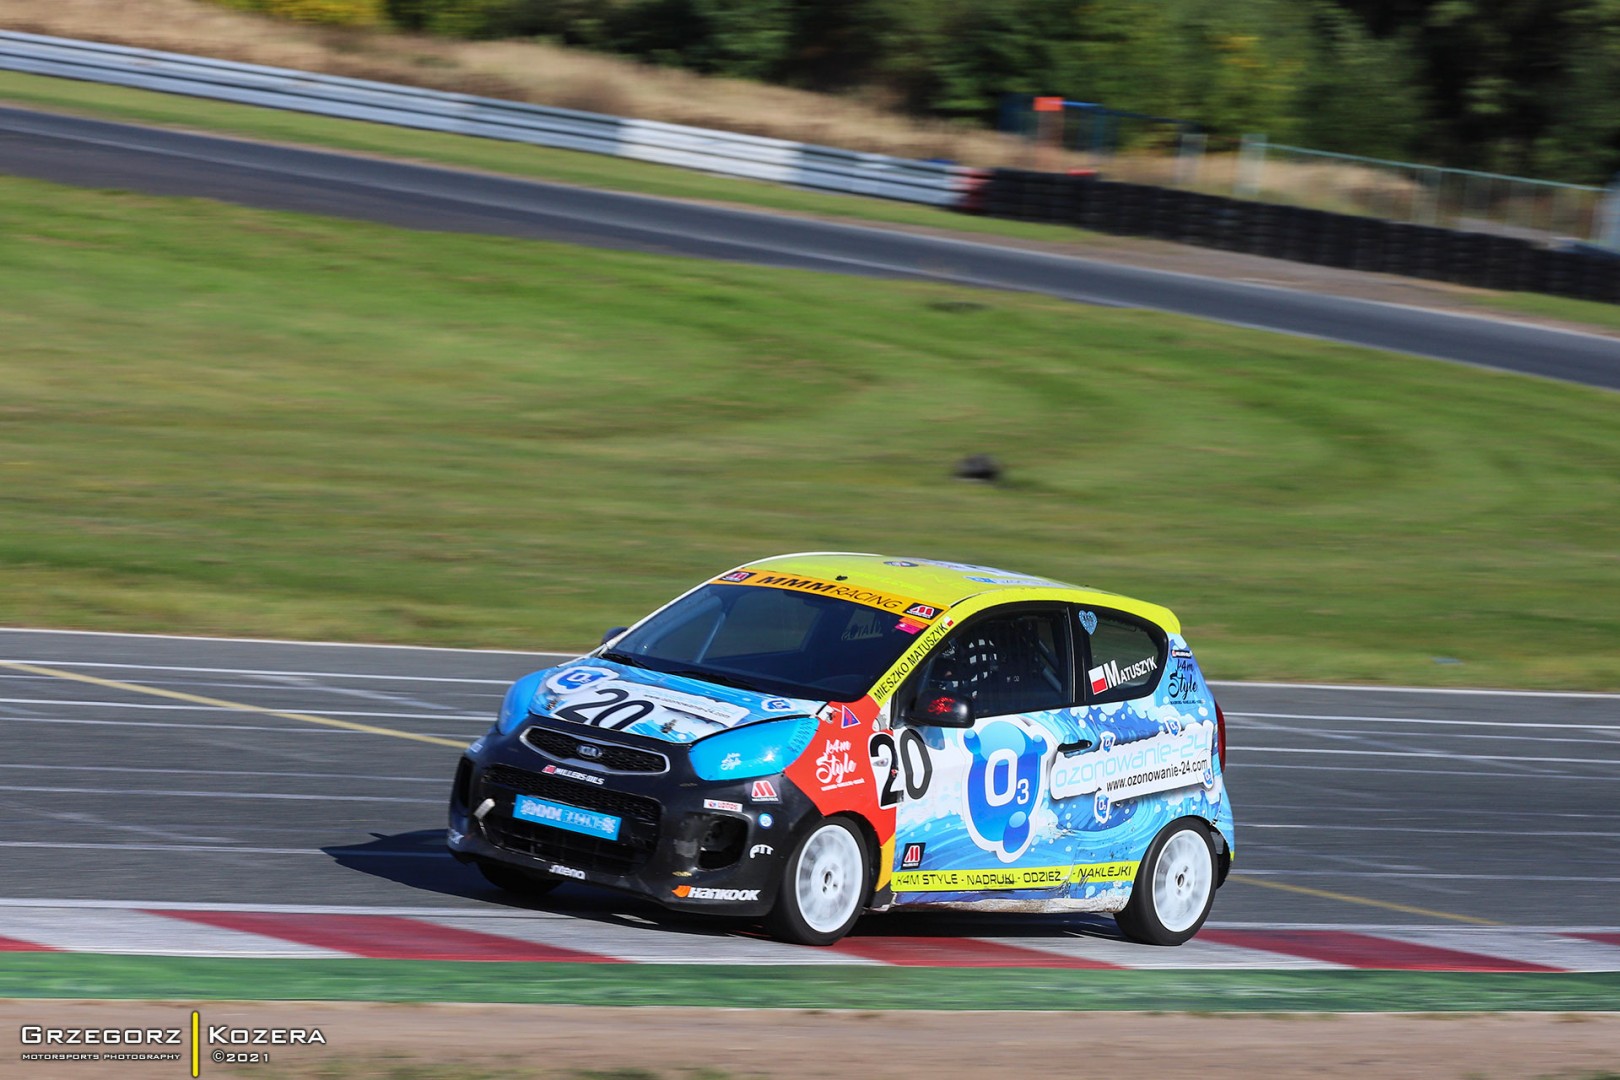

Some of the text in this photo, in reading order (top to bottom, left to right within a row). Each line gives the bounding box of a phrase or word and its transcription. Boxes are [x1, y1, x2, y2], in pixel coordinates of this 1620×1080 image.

[873, 662, 910, 701] MIESZKO
[907, 622, 949, 667] MATUSZYK
[1167, 669, 1199, 700] Style
[554, 688, 655, 732] 20
[815, 752, 857, 784] Style
[869, 728, 933, 808] 20
[1055, 730, 1209, 788] ozonowanie-24
[1106, 759, 1208, 792] www.ozonowanie-24.com
[922, 873, 958, 885] STYLE
[966, 873, 1015, 885] NADRUKI
[1078, 866, 1132, 878] NAKLEJKI
